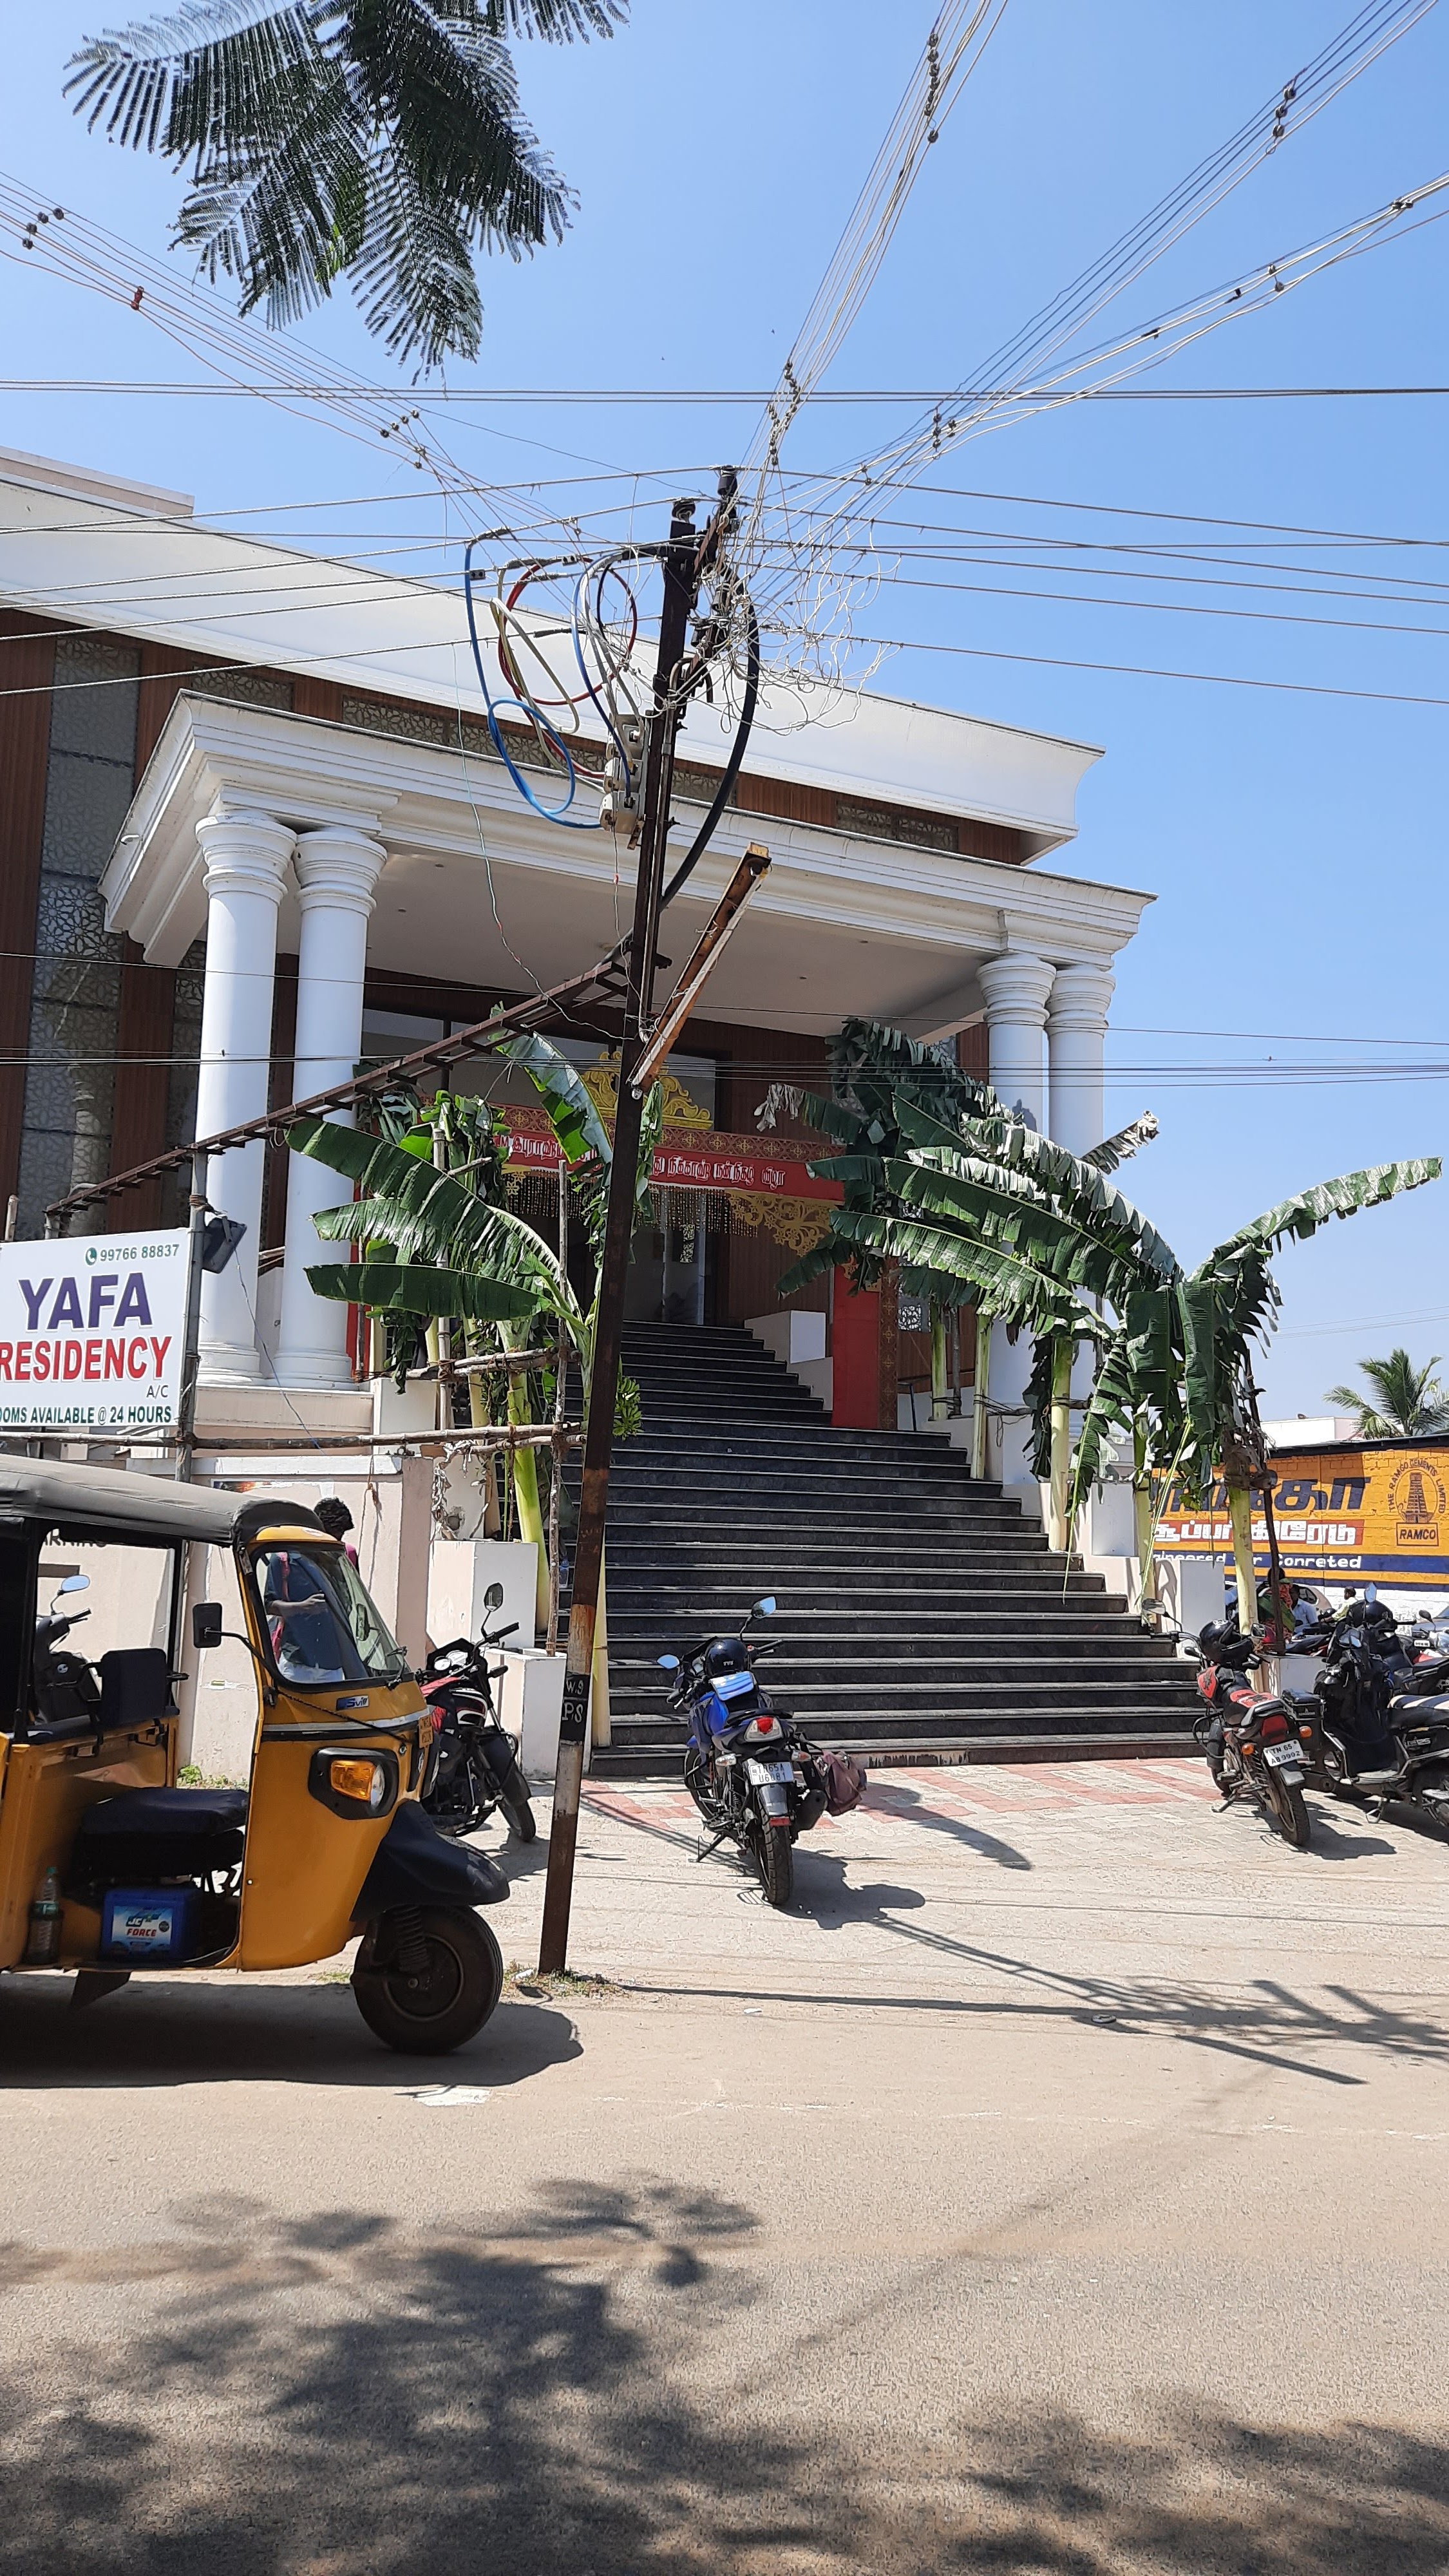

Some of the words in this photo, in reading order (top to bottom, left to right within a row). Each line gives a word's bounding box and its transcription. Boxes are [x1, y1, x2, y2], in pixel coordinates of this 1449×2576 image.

[100, 1247, 138, 1262] 99766
[141, 1244, 180, 1259] 88837
[18, 1272, 153, 1331] YAFA
[0, 1336, 173, 1381] RESIDENCY
[146, 1385, 169, 1399] A/C
[0, 1407, 27, 1423] OMS
[30, 1406, 95, 1424] AVAILABLE
[109, 1406, 124, 1423] 24
[128, 1406, 172, 1423] HOURS
[1389, 1461, 1409, 1491] RAMCO
[1410, 1459, 1437, 1477] CEMENTS
[1435, 1478, 1446, 1514] LIMITED
[1399, 1528, 1437, 1540] RAMCO
[126, 1928, 157, 1937] FORCE
